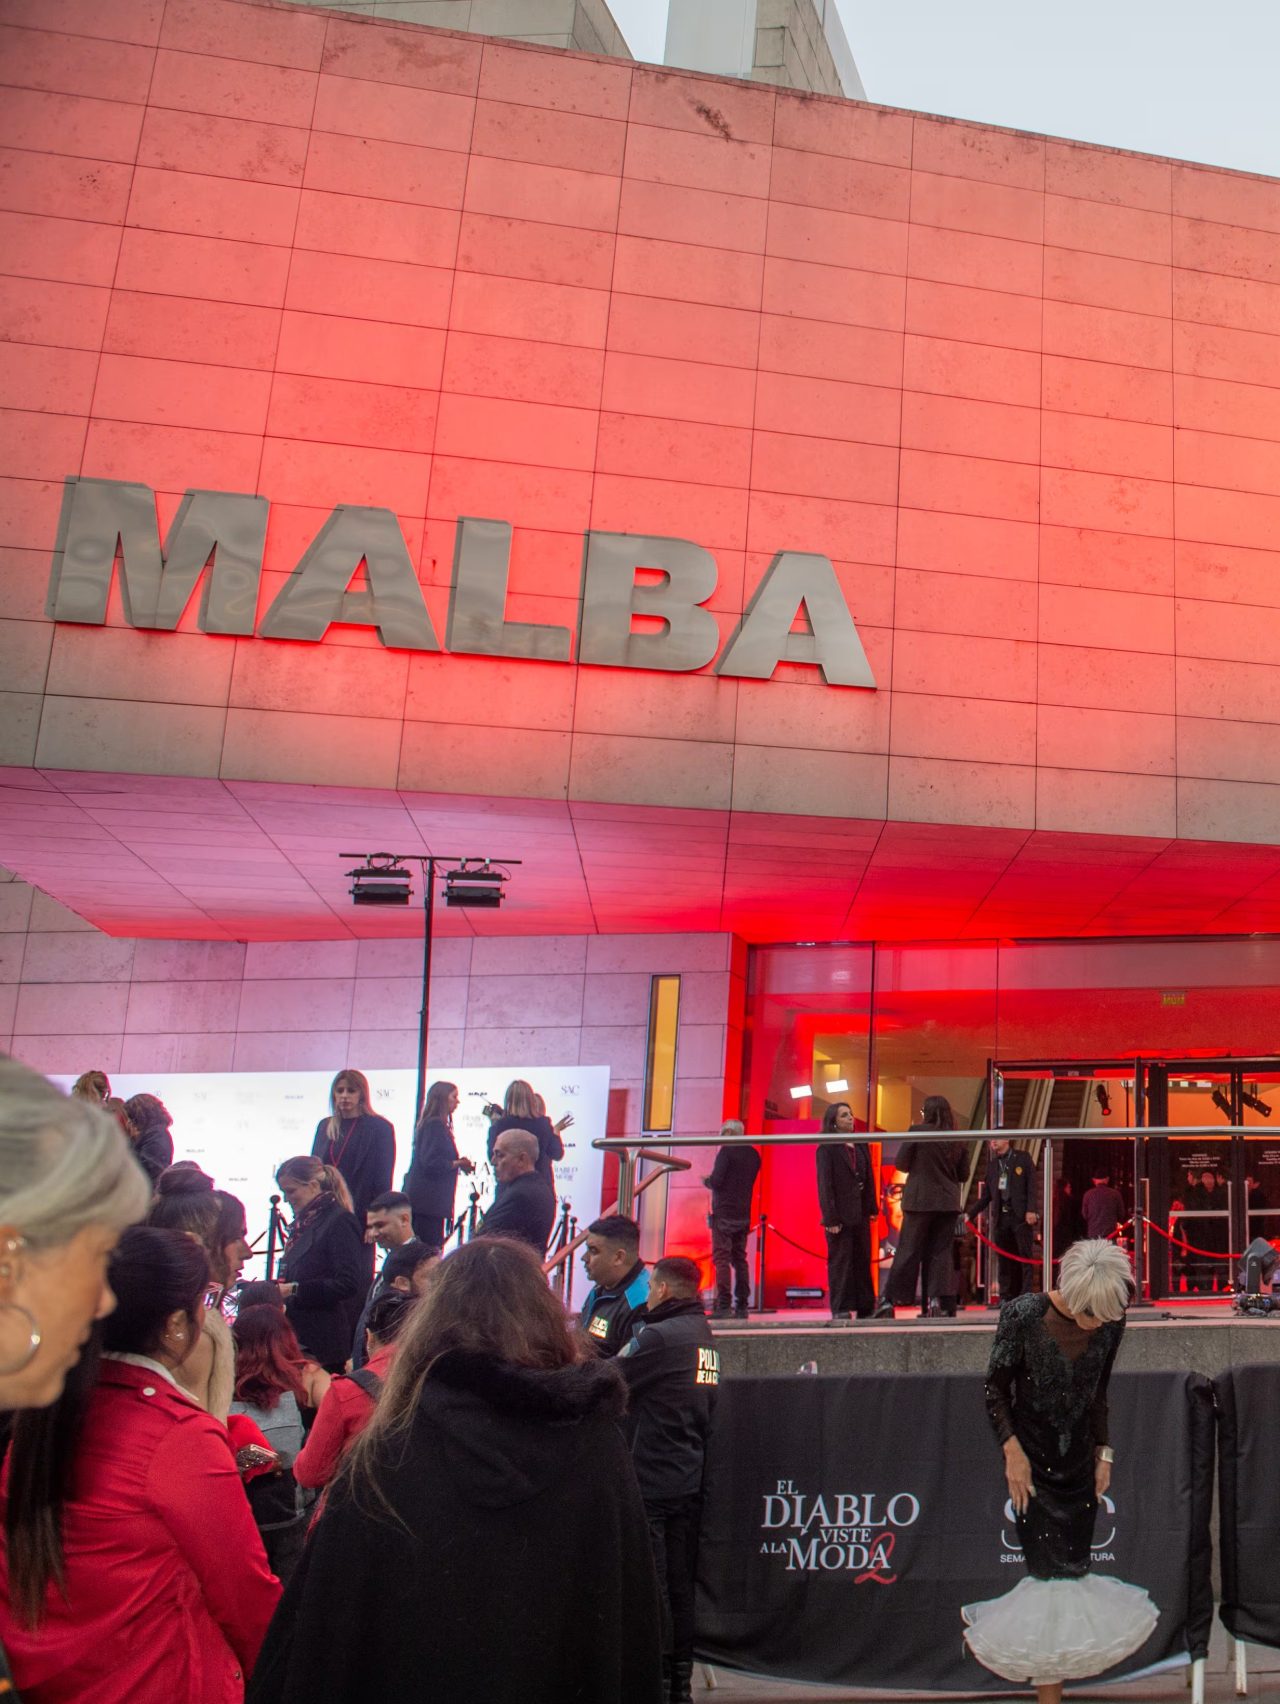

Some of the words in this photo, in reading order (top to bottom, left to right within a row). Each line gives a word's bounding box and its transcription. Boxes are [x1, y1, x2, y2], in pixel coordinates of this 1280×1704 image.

[45, 475, 879, 690] MALBA
[776, 1480, 798, 1494] EL
[761, 1492, 920, 1536] DIABLO
[820, 1528, 871, 1543] VISTE
[785, 1538, 891, 1570] MODA
